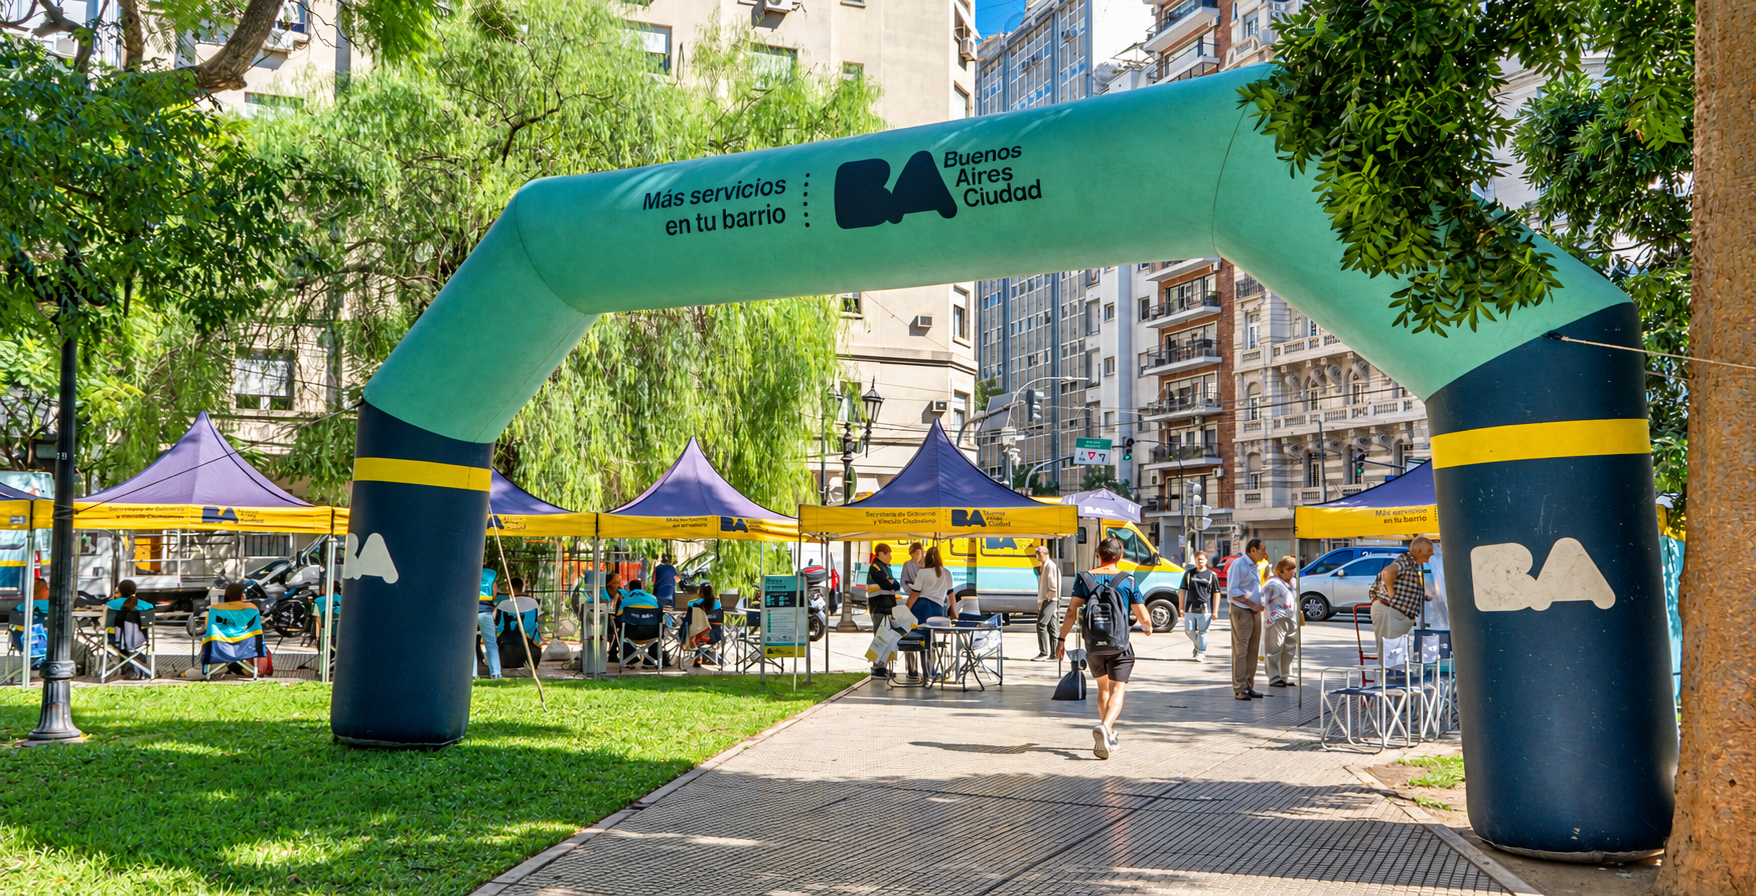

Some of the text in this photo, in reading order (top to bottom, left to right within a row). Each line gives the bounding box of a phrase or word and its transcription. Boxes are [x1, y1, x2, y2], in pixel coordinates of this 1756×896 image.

[944, 145, 1022, 168] Buenos
[834, 150, 958, 229] BA
[955, 167, 1014, 187] Aires
[643, 178, 787, 210] Más servicios
[963, 179, 1042, 207] Ciudad
[665, 204, 786, 236] en tu barrio
[202, 506, 239, 524] BA
[721, 517, 748, 533] BA
[951, 509, 986, 527] BA
[1470, 537, 1616, 612] BA
